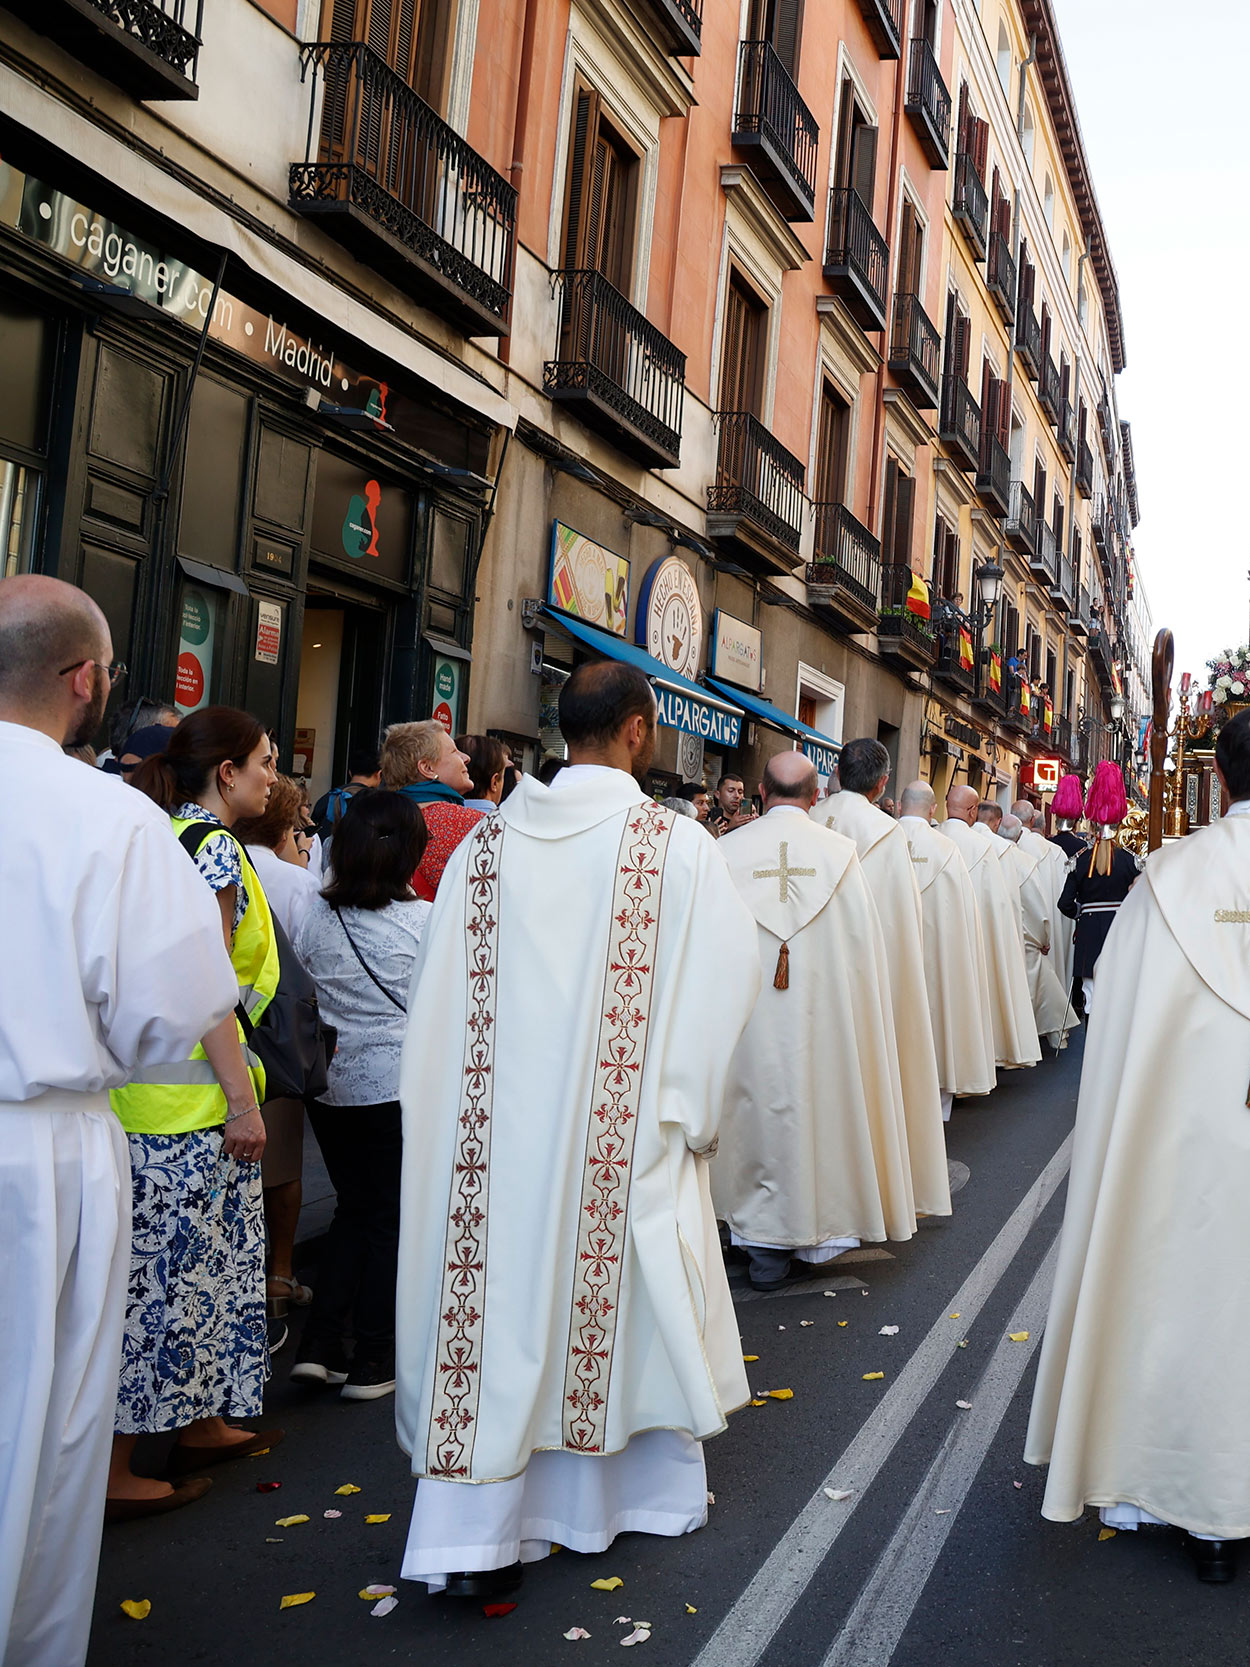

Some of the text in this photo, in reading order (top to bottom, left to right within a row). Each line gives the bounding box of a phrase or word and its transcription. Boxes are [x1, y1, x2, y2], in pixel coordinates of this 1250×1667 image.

[264, 313, 335, 387] Madrid
[653, 569, 698, 637] HECHO EN ESPAÑA
[657, 691, 738, 745] ALPARGATUS
